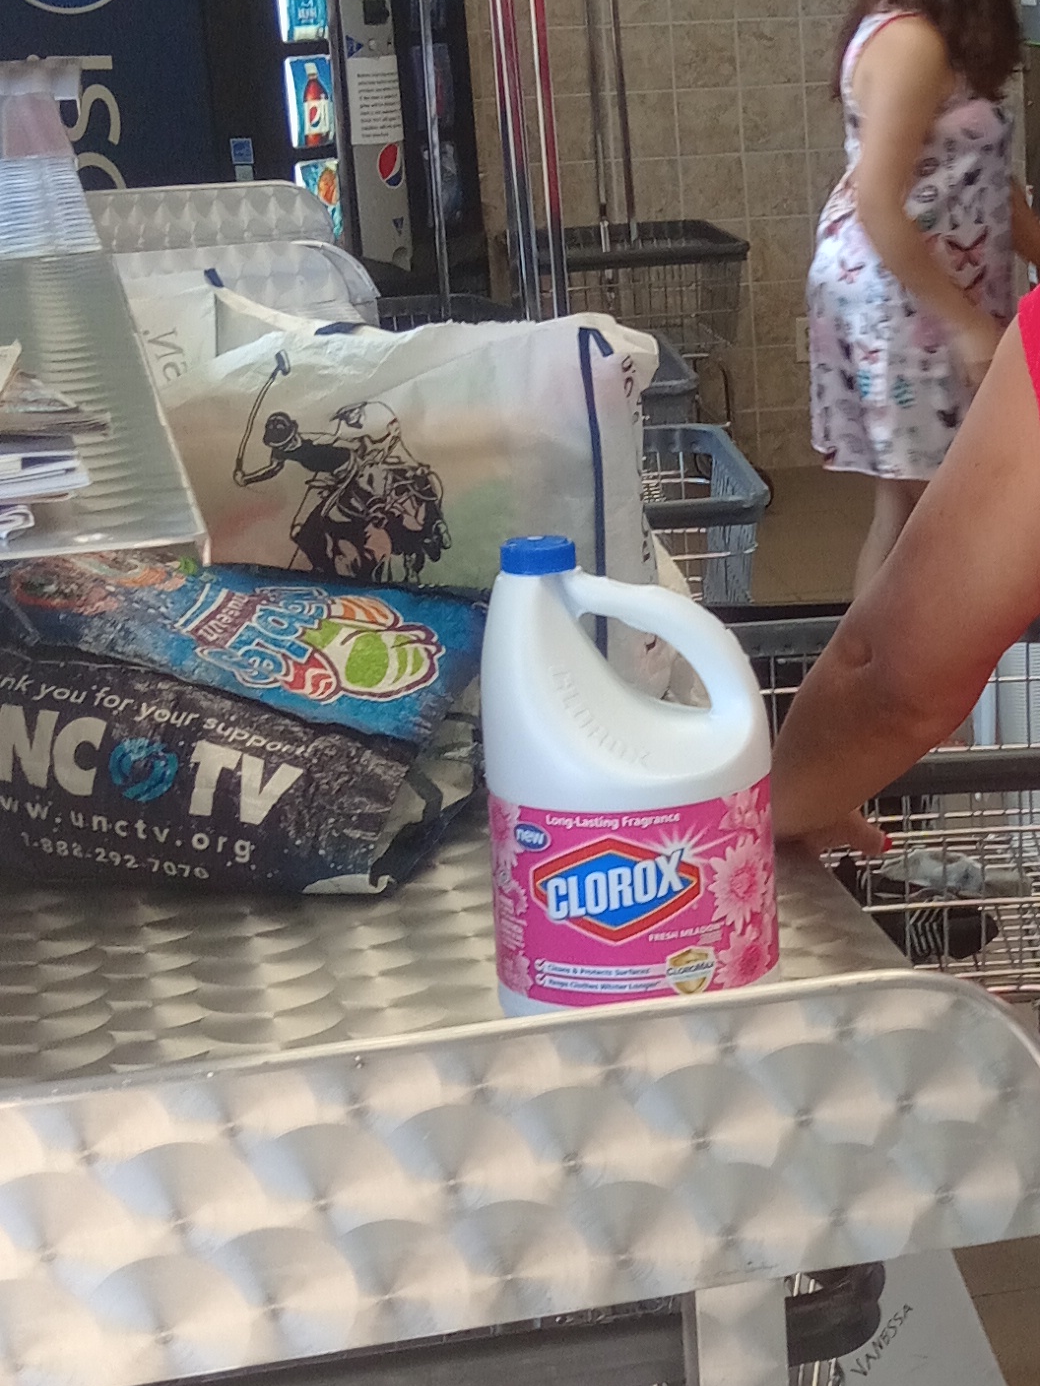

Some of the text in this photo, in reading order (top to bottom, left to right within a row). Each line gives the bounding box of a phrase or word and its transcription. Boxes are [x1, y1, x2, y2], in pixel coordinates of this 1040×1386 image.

[31, 680, 87, 703] you
[93, 685, 135, 711] for
[133, 701, 200, 728] your
[188, 739, 305, 827] TV
[515, 828, 545, 846] new
[545, 812, 681, 830] Long-Lasting Fragrance
[546, 848, 686, 921] CLOROX
[850, 1303, 914, 1377] VANESSA
